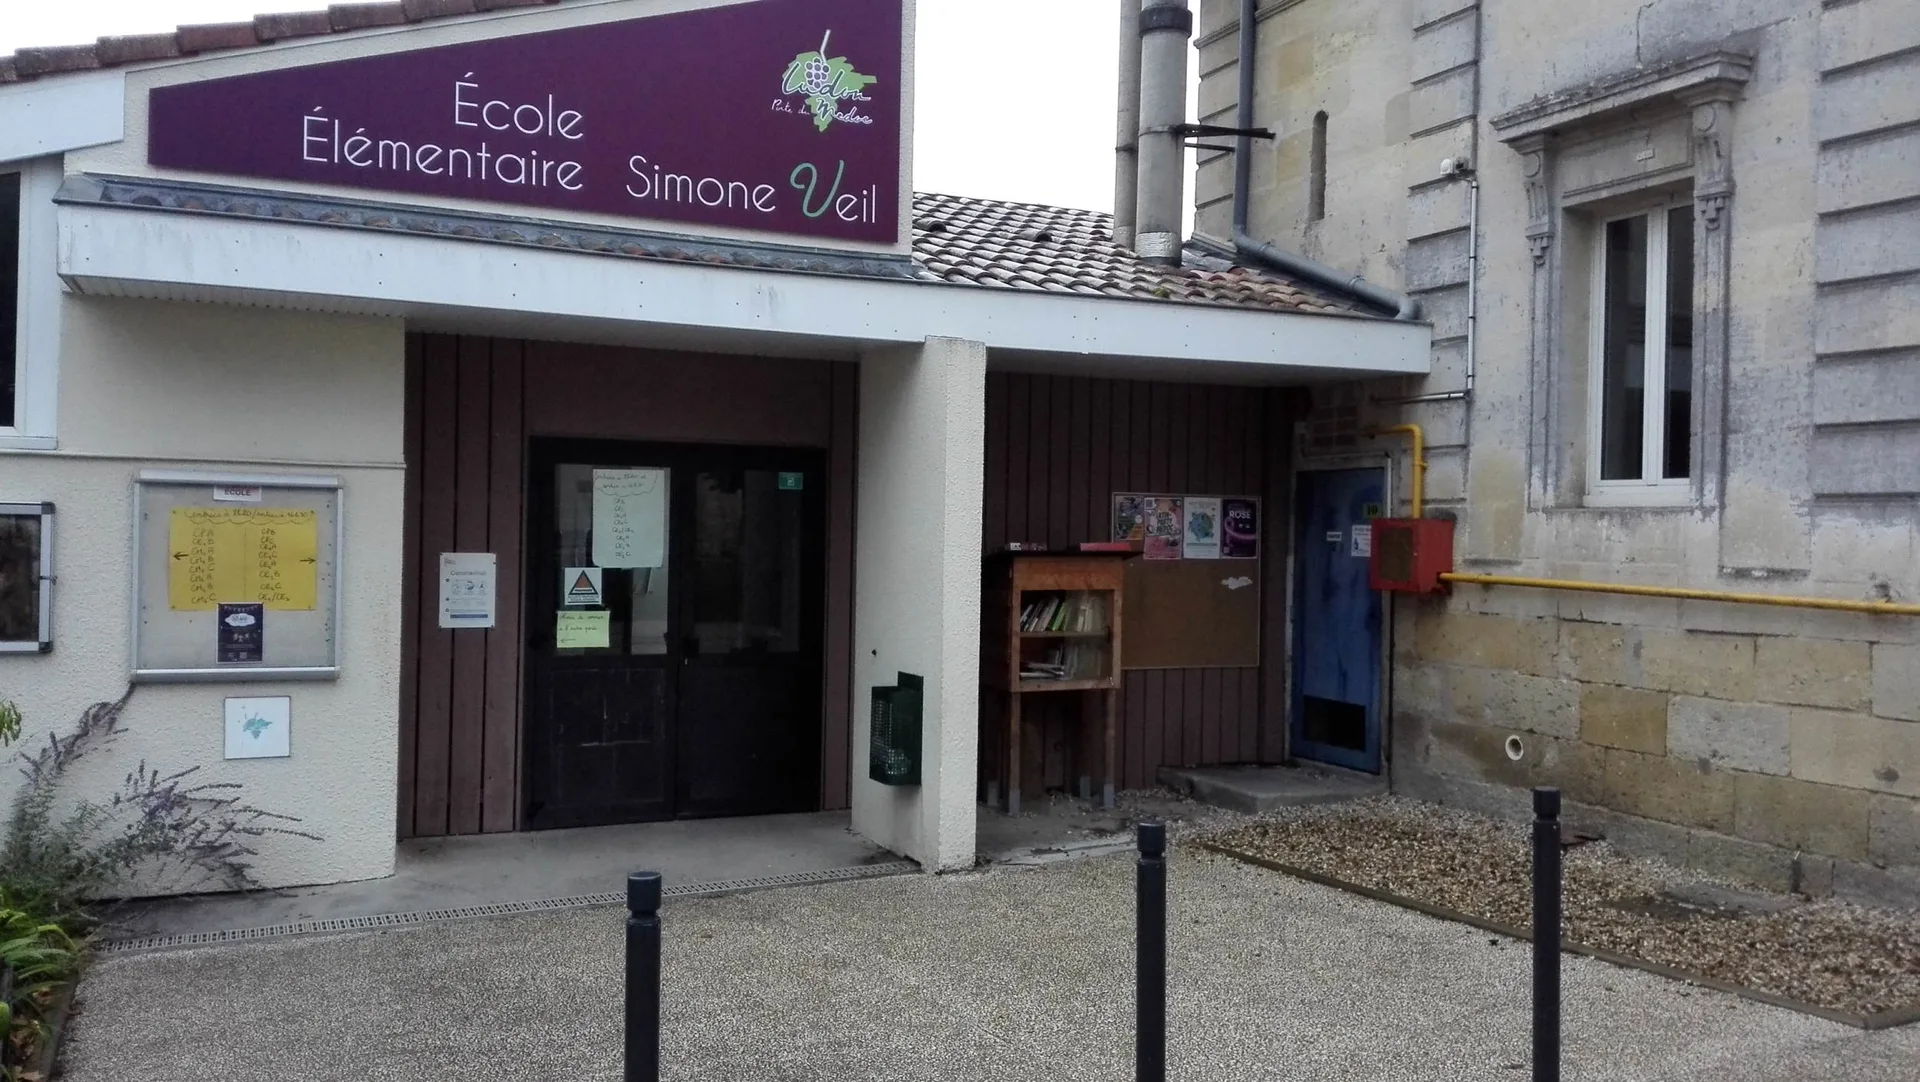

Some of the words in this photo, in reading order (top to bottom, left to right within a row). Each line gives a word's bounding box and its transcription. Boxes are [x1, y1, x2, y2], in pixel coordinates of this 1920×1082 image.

[455, 71, 584, 140] École
[782, 62, 872, 100] Ludon
[303, 106, 583, 190] Élémentaire
[626, 155, 776, 212] Simone
[789, 160, 876, 223] Veil
[1229, 510, 1252, 519] ROSE
